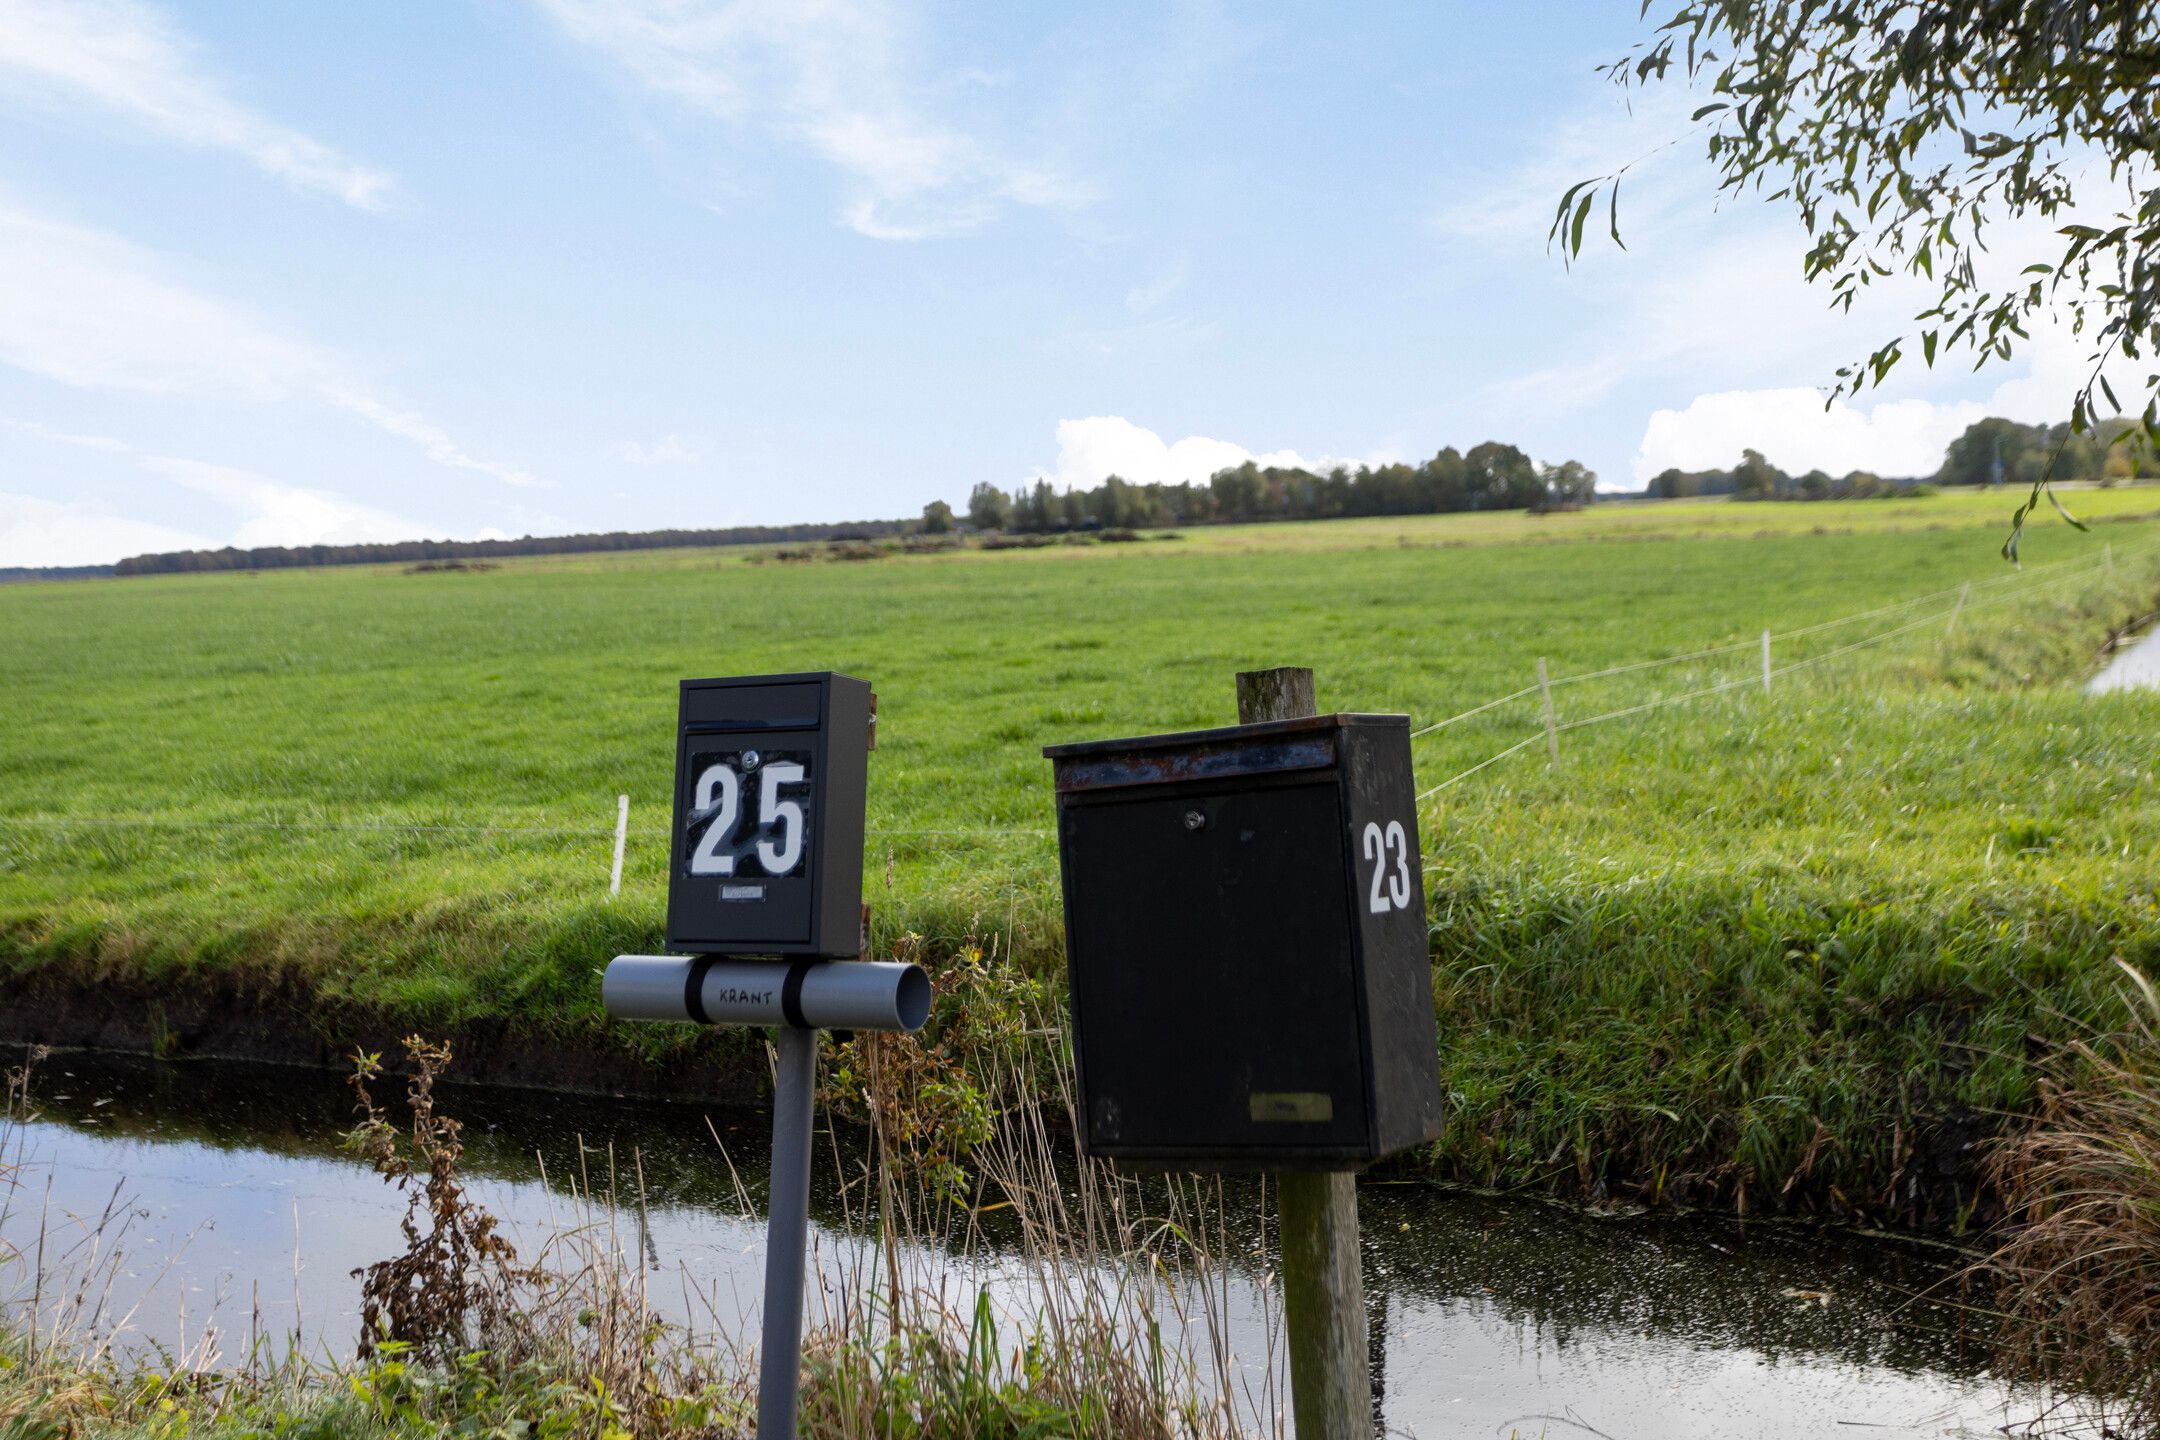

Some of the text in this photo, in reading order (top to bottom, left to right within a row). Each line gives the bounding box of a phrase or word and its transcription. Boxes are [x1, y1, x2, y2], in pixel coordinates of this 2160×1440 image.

[692, 762, 804, 873] 25
[1363, 821, 1410, 913] 23
[720, 988, 772, 1005] KRANT
